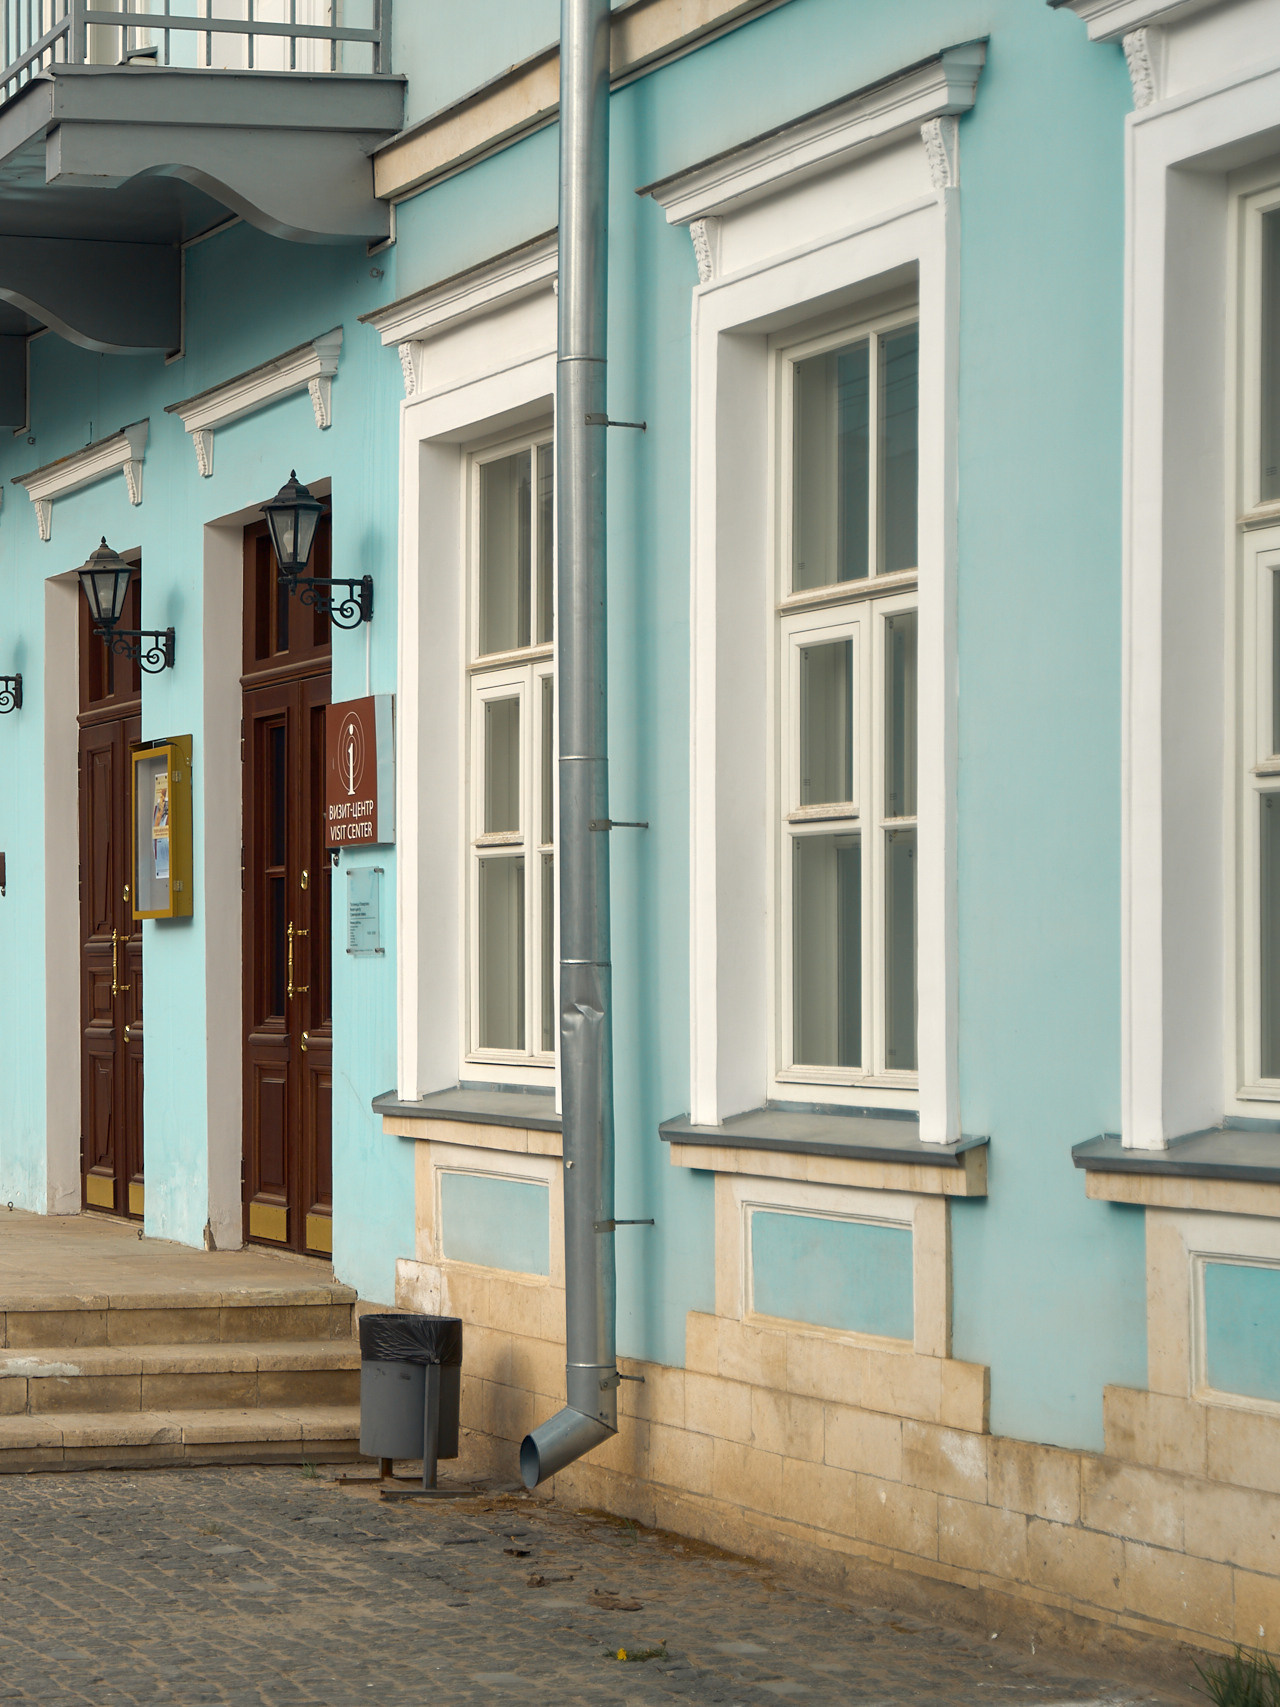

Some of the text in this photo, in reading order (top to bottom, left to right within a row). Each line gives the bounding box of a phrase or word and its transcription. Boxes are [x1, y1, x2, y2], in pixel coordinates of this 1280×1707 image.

[329, 799, 374, 820] ВИЗИТ-ЦЕНТР
[330, 821, 373, 841] VISIT CENTER
